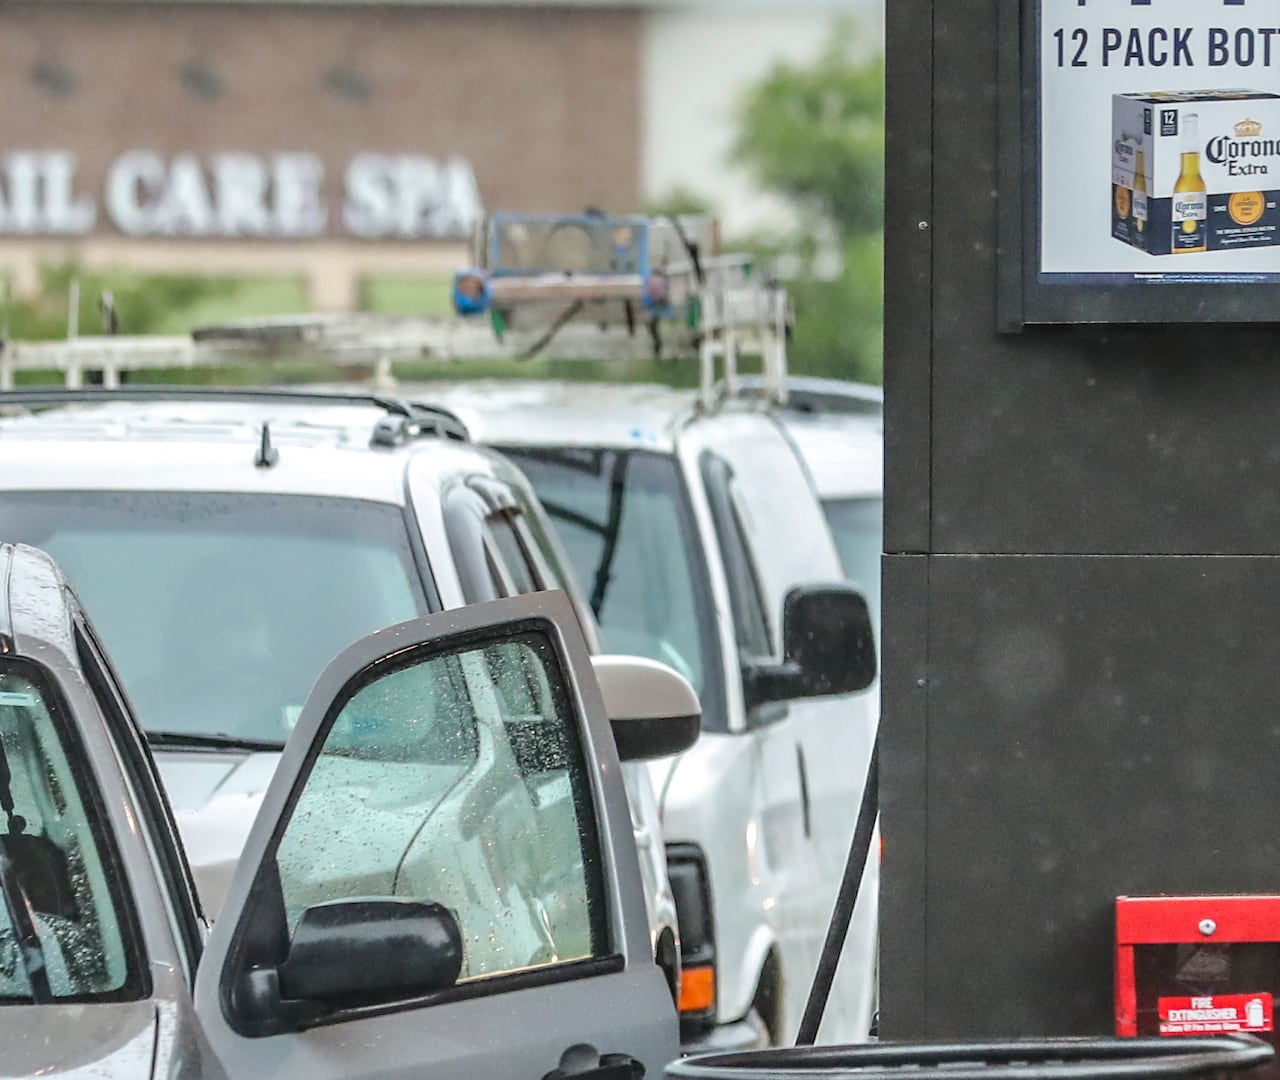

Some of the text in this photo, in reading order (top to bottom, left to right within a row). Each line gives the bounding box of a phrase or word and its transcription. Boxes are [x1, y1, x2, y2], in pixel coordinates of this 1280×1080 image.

[1053, 28, 1088, 67] 12
[1102, 27, 1194, 67] PACK
[1164, 111, 1175, 124] 12
[1227, 160, 1268, 176] Extra
[105, 150, 327, 236] CARE
[342, 151, 484, 237] SPA
[1191, 997, 1213, 1009] FIRE
[1168, 1008, 1237, 1021] EXTINGUISHER
